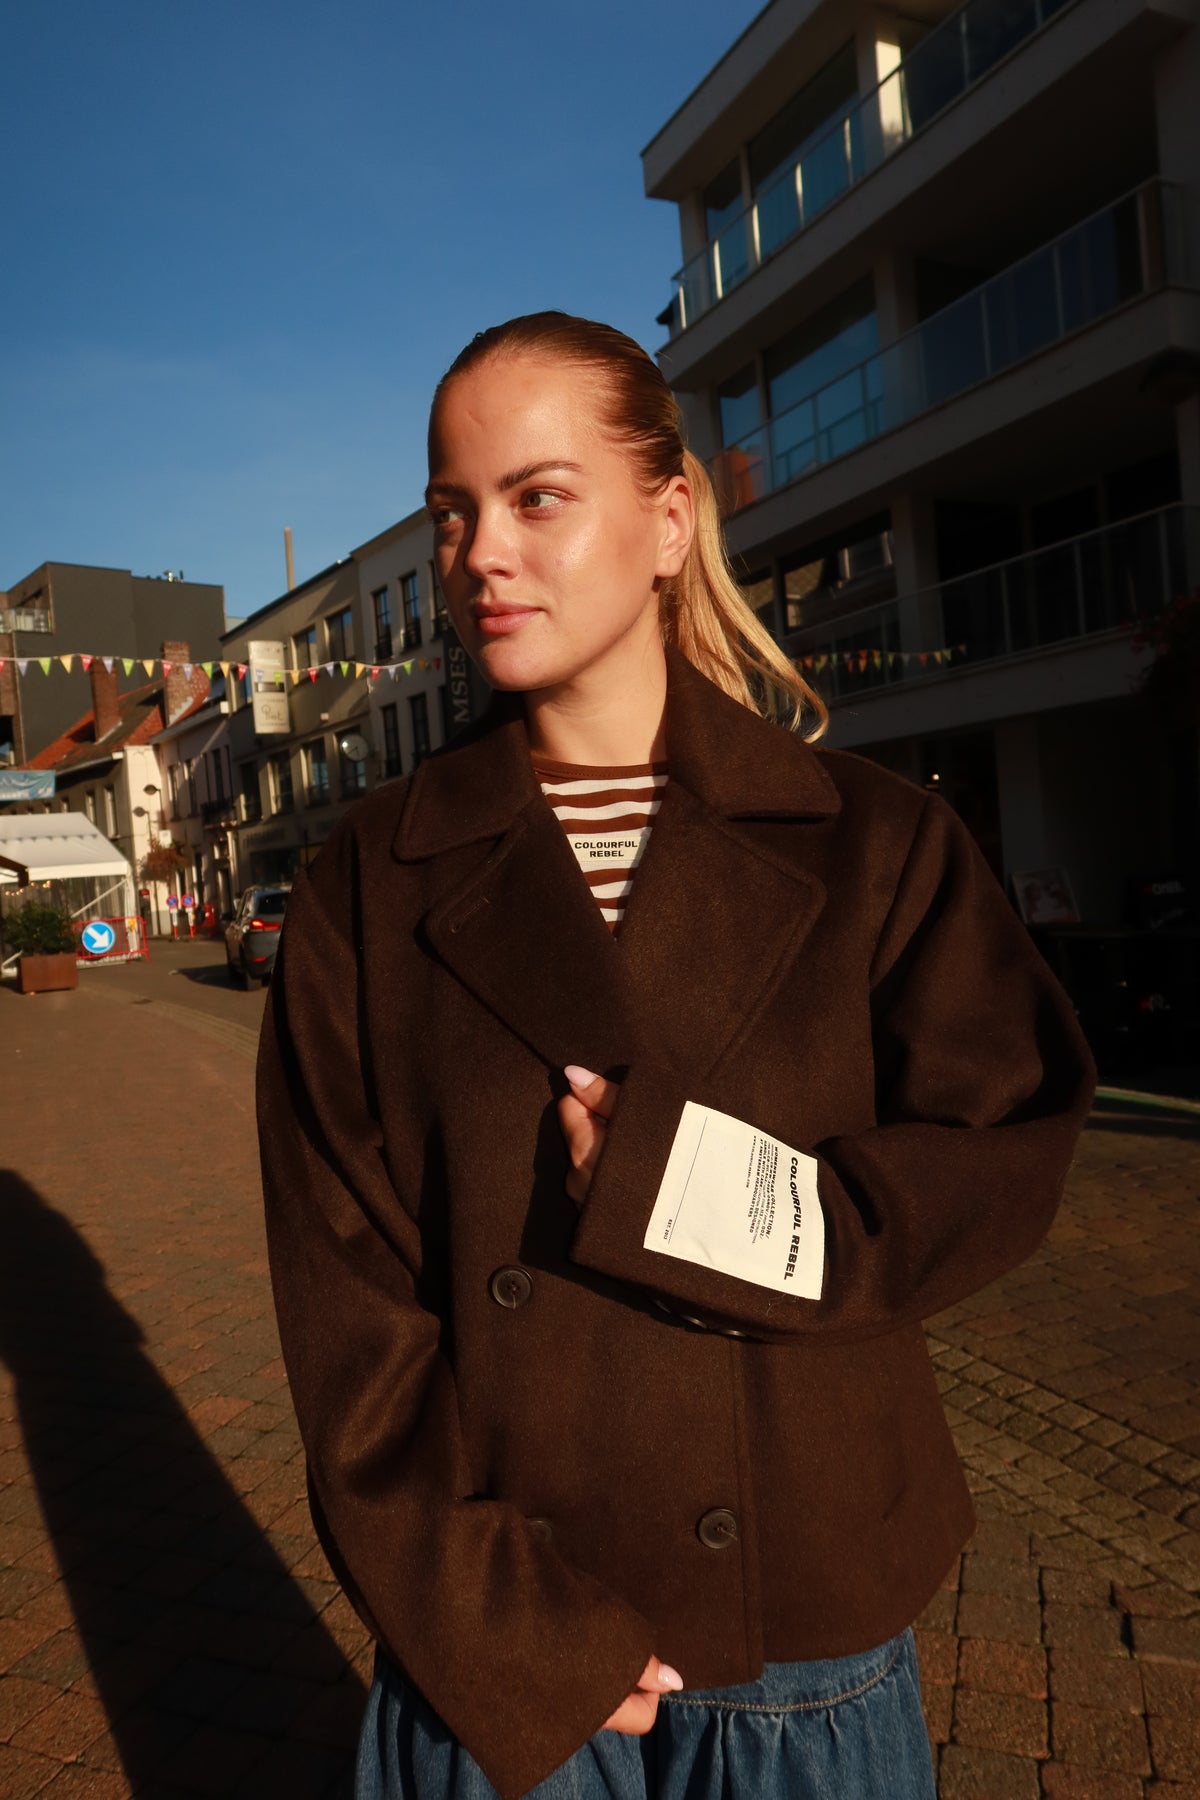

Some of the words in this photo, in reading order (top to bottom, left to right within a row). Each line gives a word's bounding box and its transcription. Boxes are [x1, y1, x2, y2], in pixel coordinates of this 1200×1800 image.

[574, 841, 638, 849] COLOURFUL
[589, 850, 624, 858] REBEL
[747, 1177, 760, 1218] HEADQUARTERS
[789, 1157, 801, 1230] COLOURFUL
[749, 1207, 760, 1233] DESIGNED
[784, 1234, 801, 1281] REBEL
